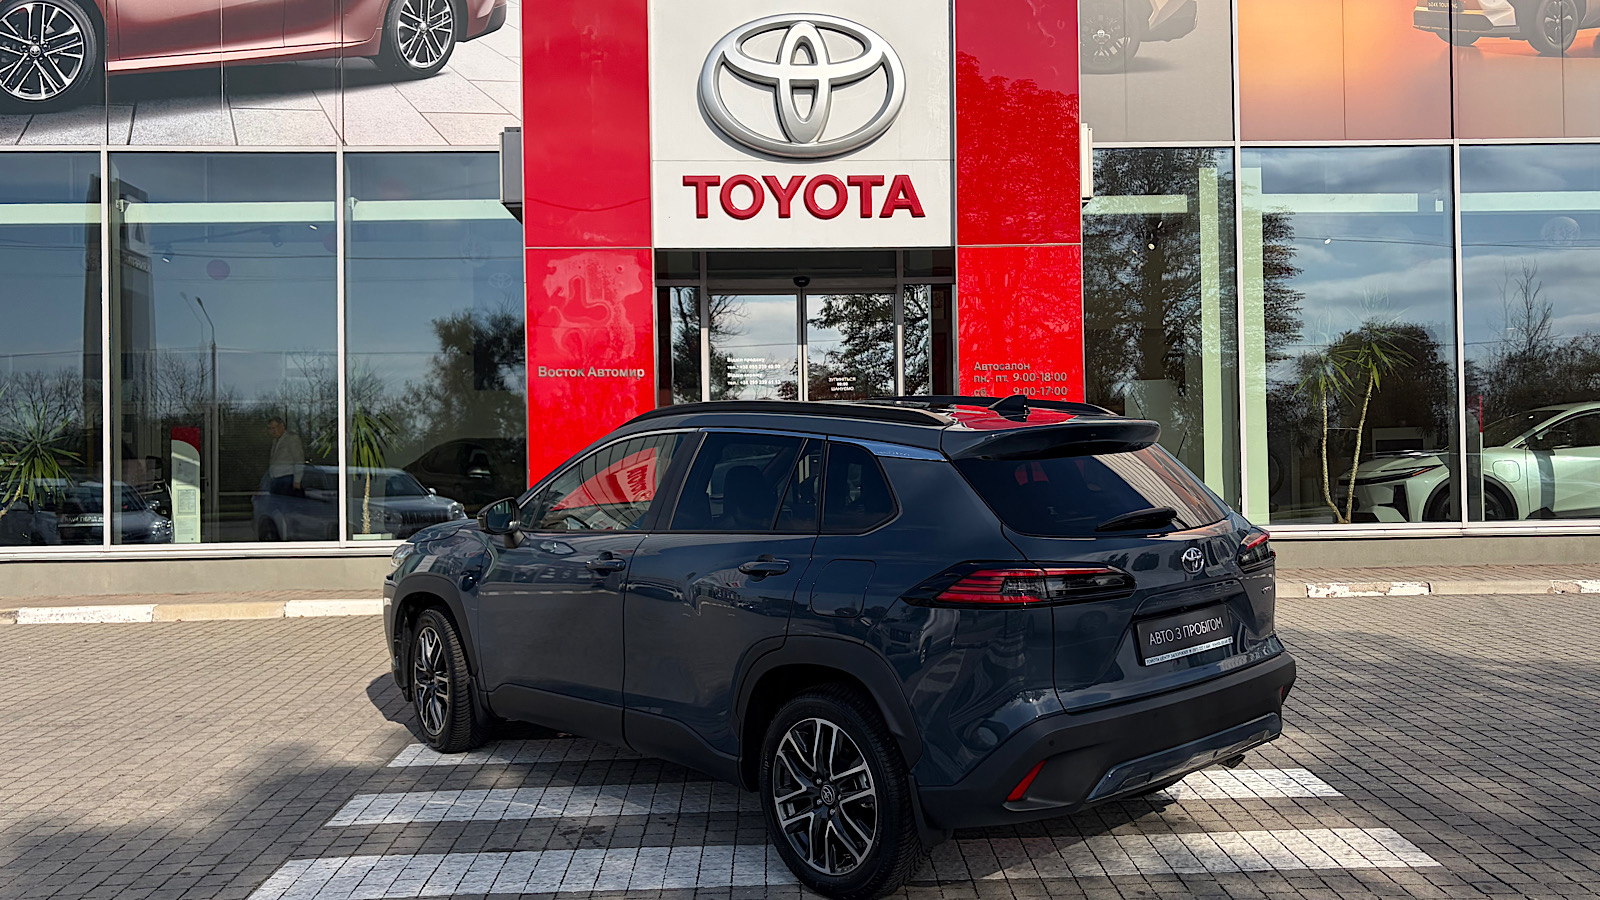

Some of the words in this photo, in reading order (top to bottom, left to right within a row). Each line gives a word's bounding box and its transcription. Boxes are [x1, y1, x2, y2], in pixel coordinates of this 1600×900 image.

[682, 174, 926, 220] TOYOTA
[538, 366, 585, 377] Восток
[587, 366, 645, 380] Автомир
[974, 362, 1030, 371] Автосалон
[1012, 386, 1068, 396] 9:00-17:00
[1149, 629, 1174, 646] АВТО
[1182, 617, 1224, 638] ПРОБІГОМ
